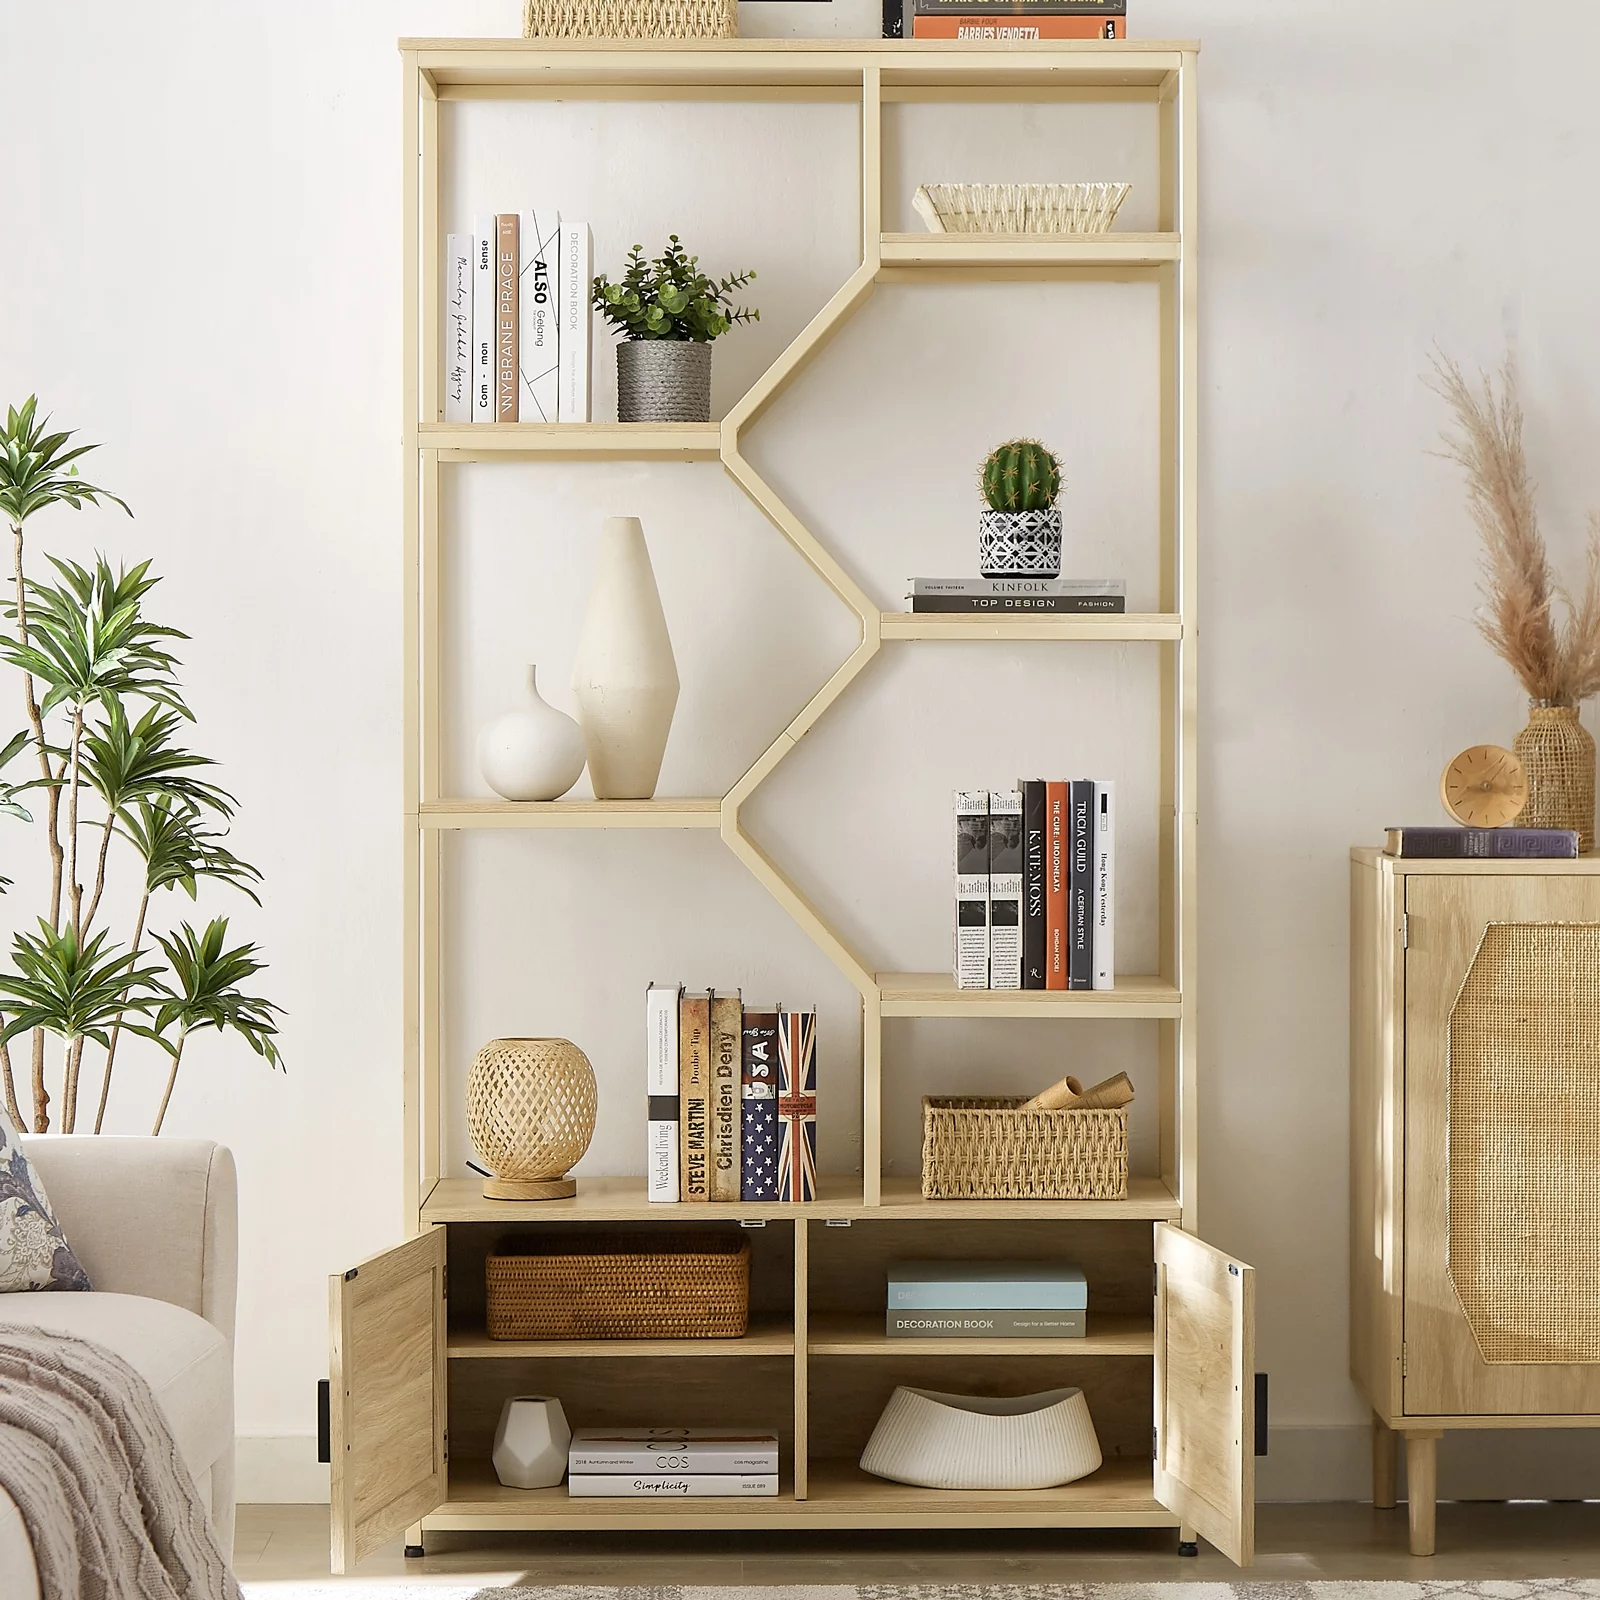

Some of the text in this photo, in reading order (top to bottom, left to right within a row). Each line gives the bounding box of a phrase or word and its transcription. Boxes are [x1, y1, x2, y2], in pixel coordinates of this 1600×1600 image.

[996, 27, 1039, 39] VENDETTA
[480, 240, 489, 270] Sense
[534, 260, 547, 304] ALSO
[569, 232, 579, 330] DECORATION BOOK
[501, 252, 513, 413] WYBRANE PRACE
[479, 384, 489, 408] Com
[992, 582, 1049, 592] KINFOLK
[972, 599, 1056, 607] TOP DESIGN
[1077, 801, 1087, 873] TRICIA GUILD
[1029, 830, 1041, 917] KATE MOSS
[1099, 893, 1107, 927] Yesterday
[1077, 927, 1085, 950] STYLE
[690, 1028, 701, 1046] Tap
[716, 1031, 736, 1170] Chrisdien Deny
[655, 1124, 672, 1190] Weekend living
[688, 1098, 705, 1194] STEVE MARTINI
[896, 1320, 994, 1329] DECORATION BOOK
[656, 1456, 690, 1469] COS
[633, 1480, 691, 1493] Simplicity
